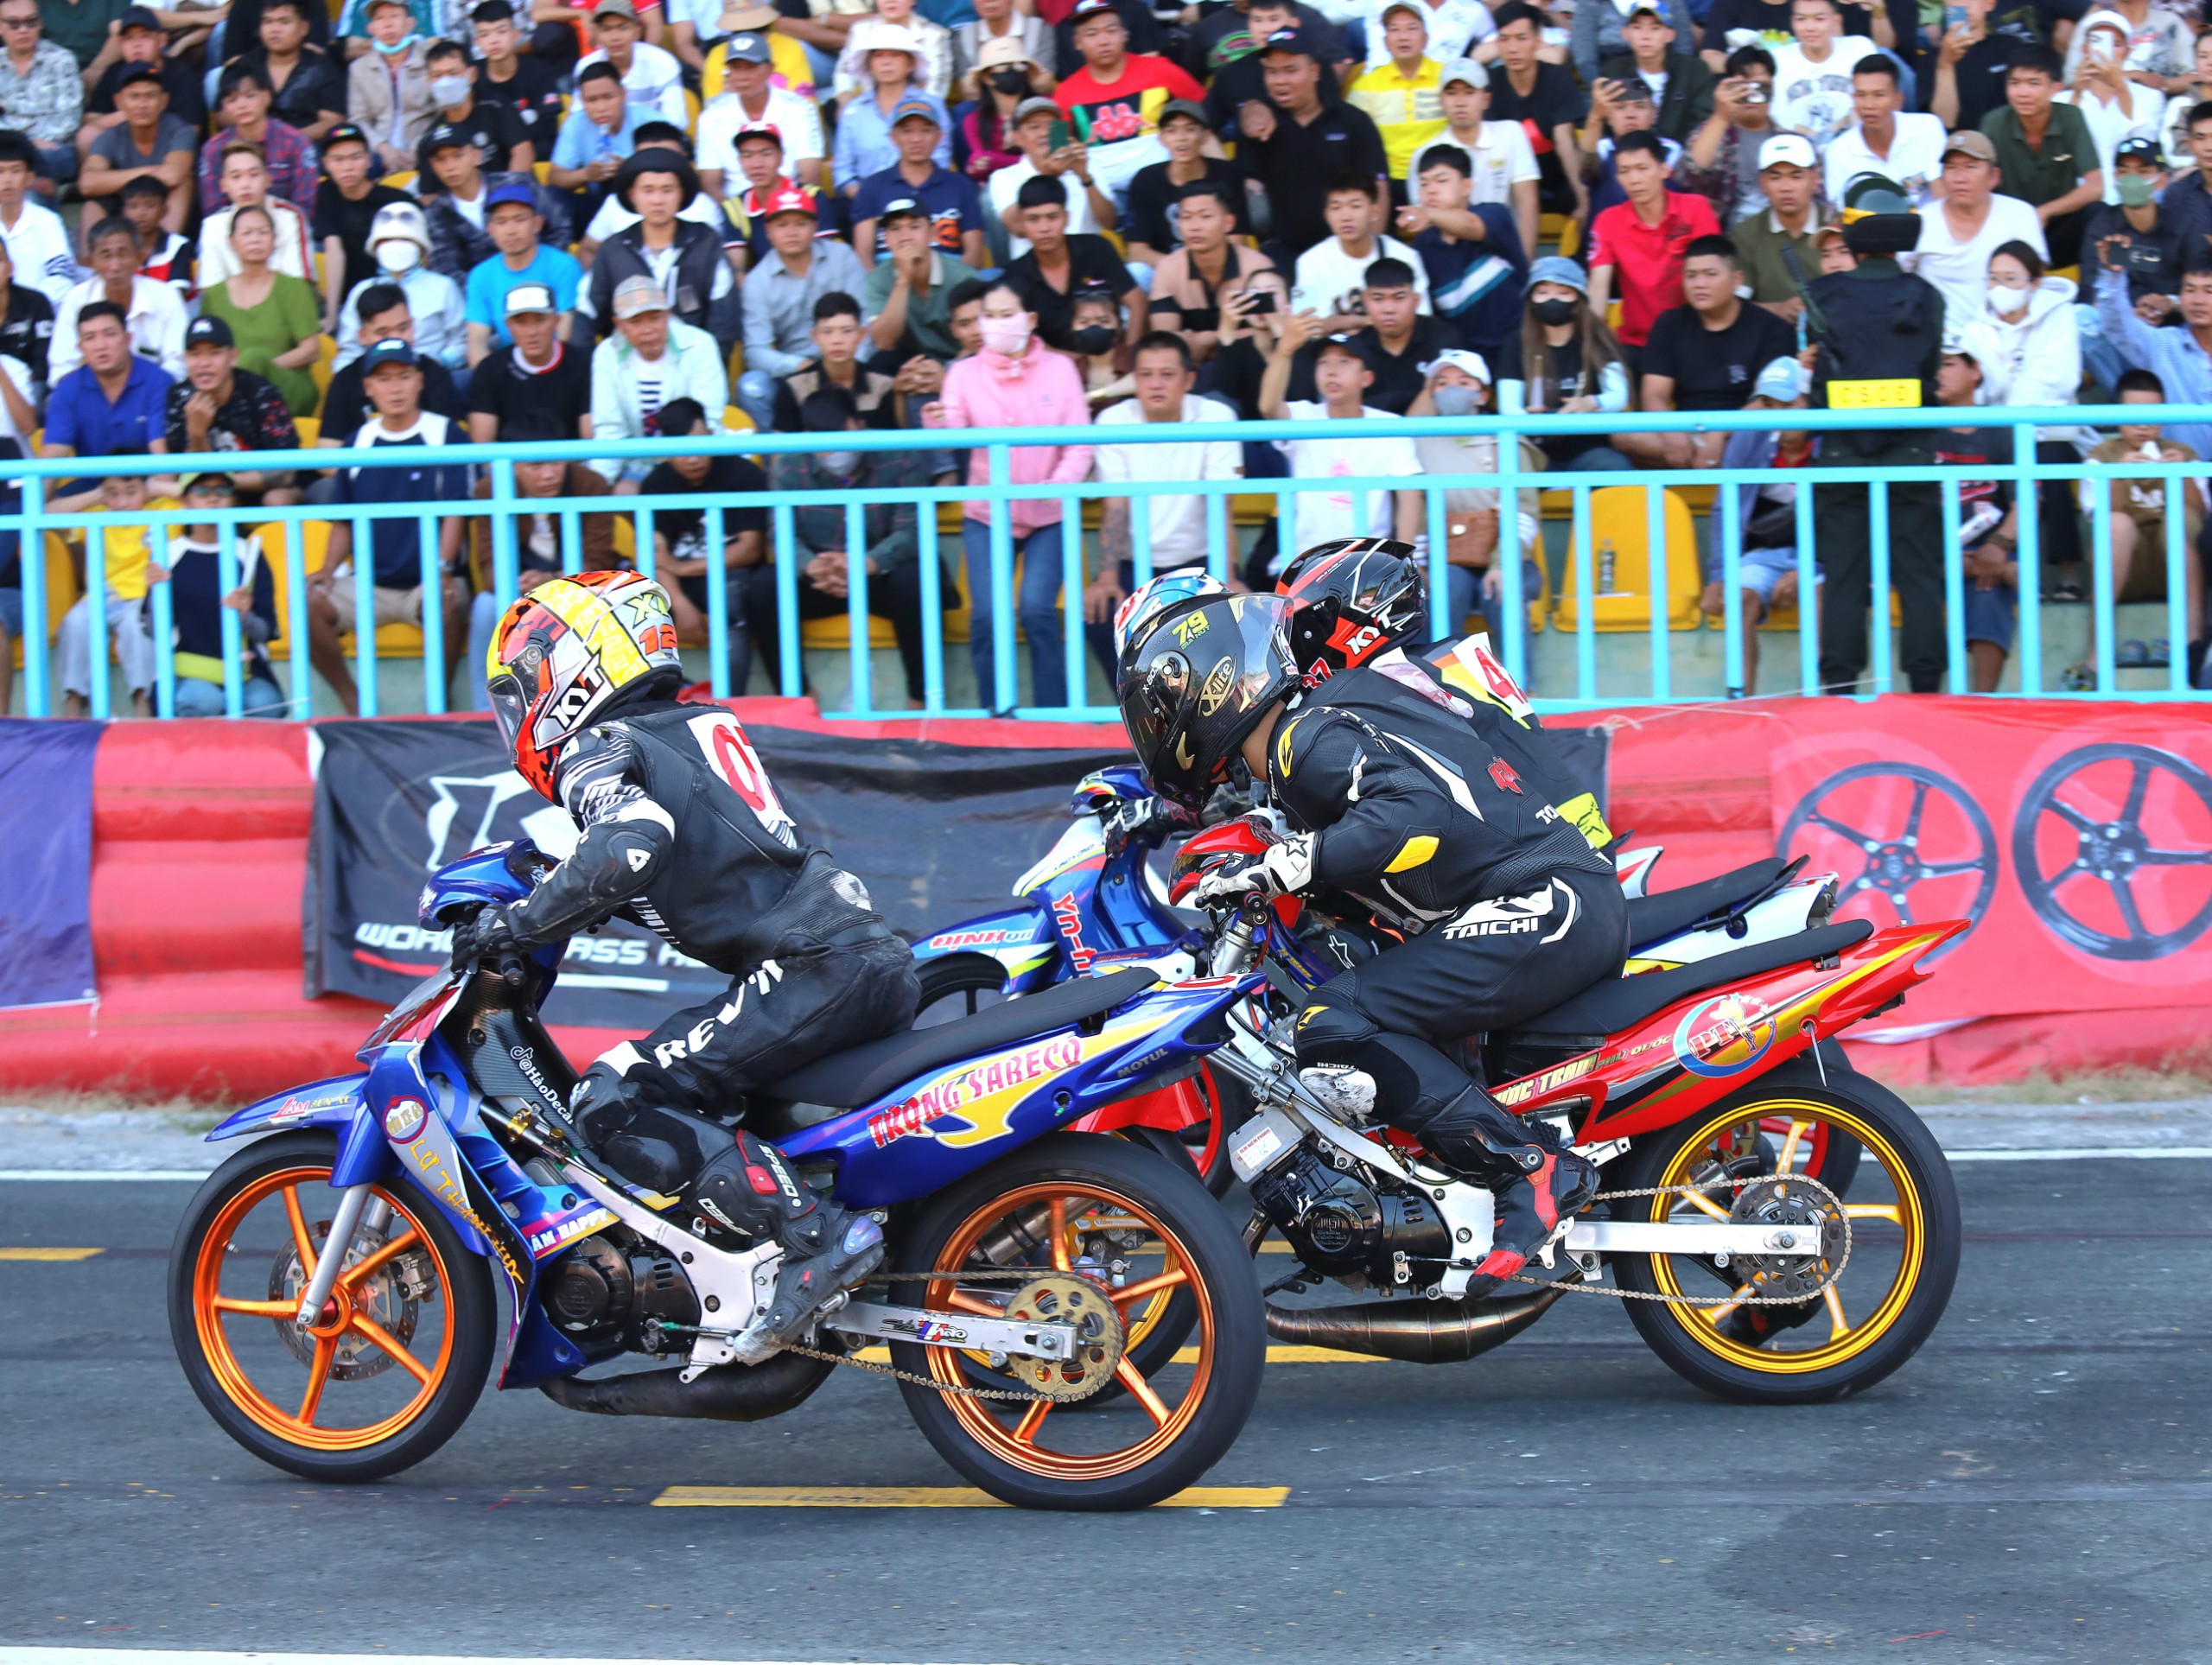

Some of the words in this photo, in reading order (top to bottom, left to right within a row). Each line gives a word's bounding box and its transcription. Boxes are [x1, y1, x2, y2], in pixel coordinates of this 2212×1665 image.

[639, 623, 677, 656] 12
[1172, 610, 1209, 647] 79
[1345, 604, 1394, 656] KYT
[1302, 657, 1333, 690] 37
[549, 654, 606, 729] KYT
[1440, 916, 1539, 941] TAICHI
[969, 1038, 1081, 1098] SABECO
[1118, 1047, 1168, 1079] MOTUL
[758, 1144, 799, 1198] SPEED
[557, 1207, 612, 1241] HAPPY
